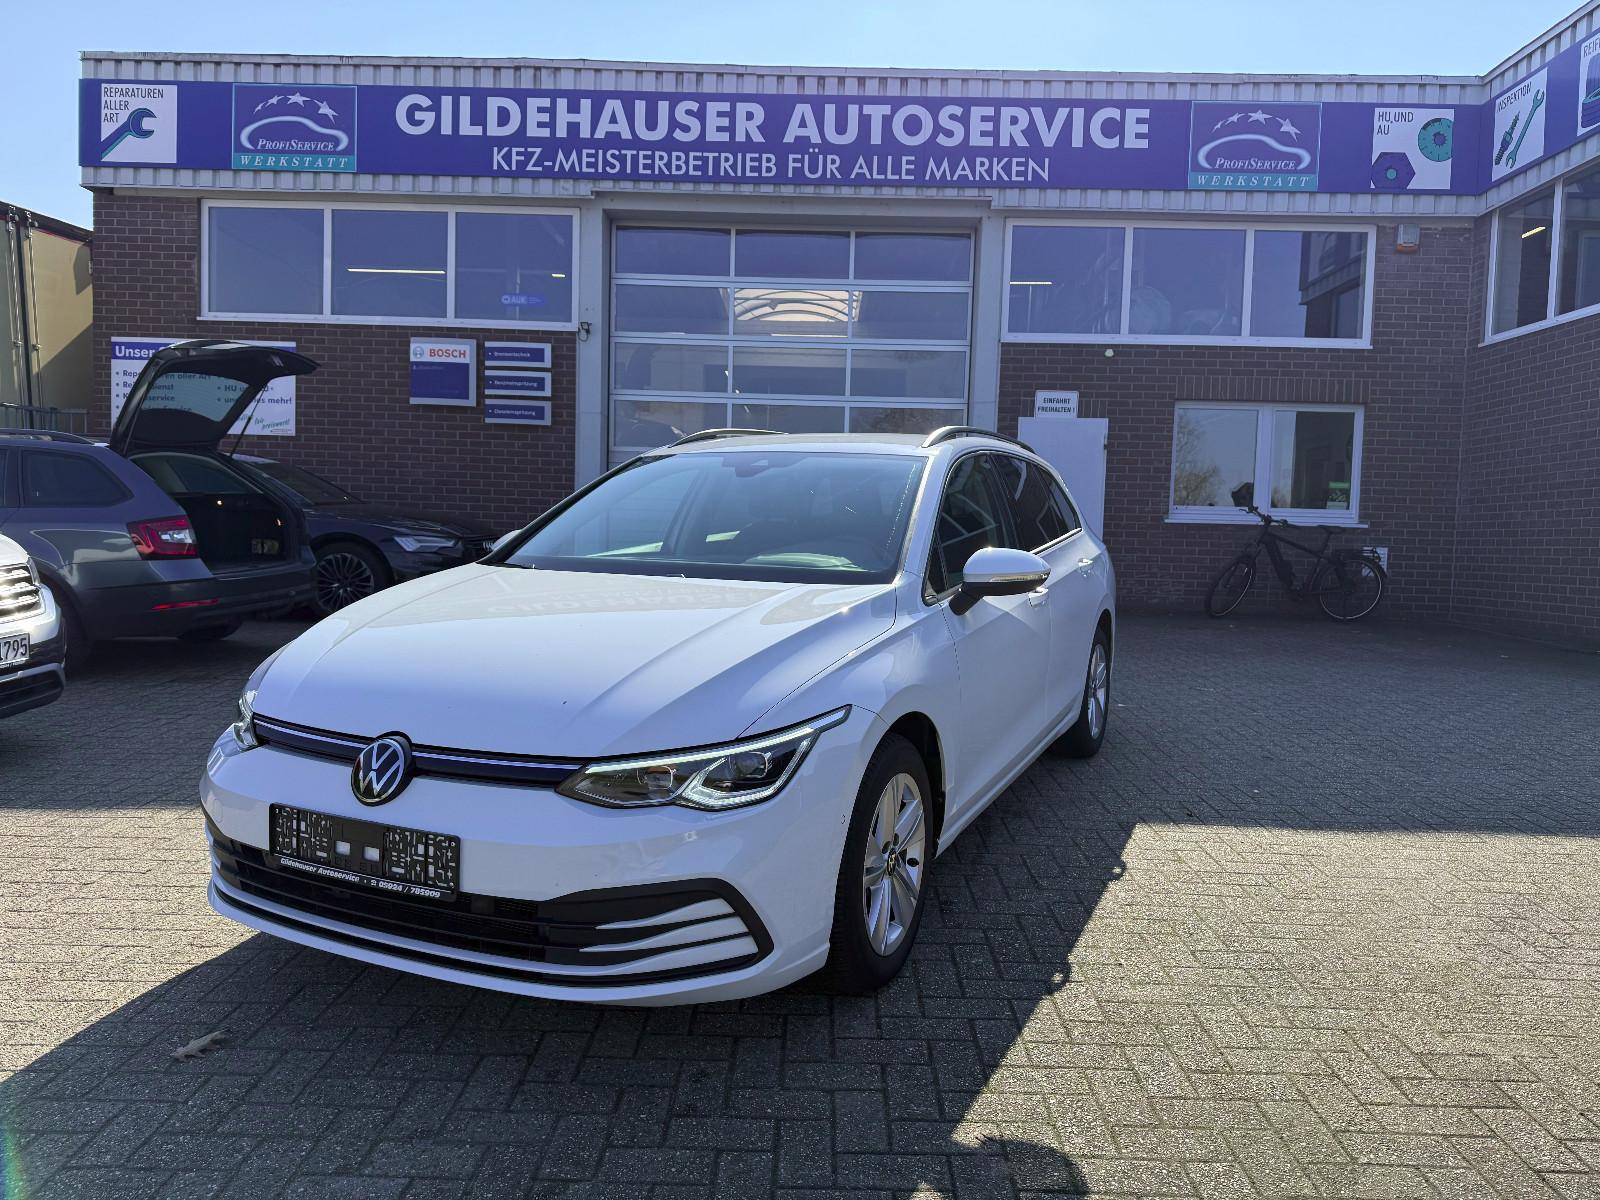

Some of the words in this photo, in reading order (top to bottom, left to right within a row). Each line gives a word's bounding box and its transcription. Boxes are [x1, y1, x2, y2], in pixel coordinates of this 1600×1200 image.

[103, 86, 164, 99] REPARATUREN
[103, 99, 129, 110] ALLER
[103, 112, 119, 123] ART
[395, 93, 765, 144] GILDEHAUSER
[783, 103, 1151, 149] AUTOSERVICE
[1377, 125, 1390, 135] AU
[240, 155, 348, 168] WERKSTATT
[493, 147, 777, 178] KFZ-MEISTERBETRIEB
[787, 148, 842, 179] FÜR
[850, 155, 916, 180] ALLE
[925, 156, 1050, 183] MARKEN
[1198, 175, 1309, 187] WERKSTATT
[115, 346, 155, 357] Unser
[429, 348, 467, 358] BOSCH
[317, 867, 360, 882] Autoservice
